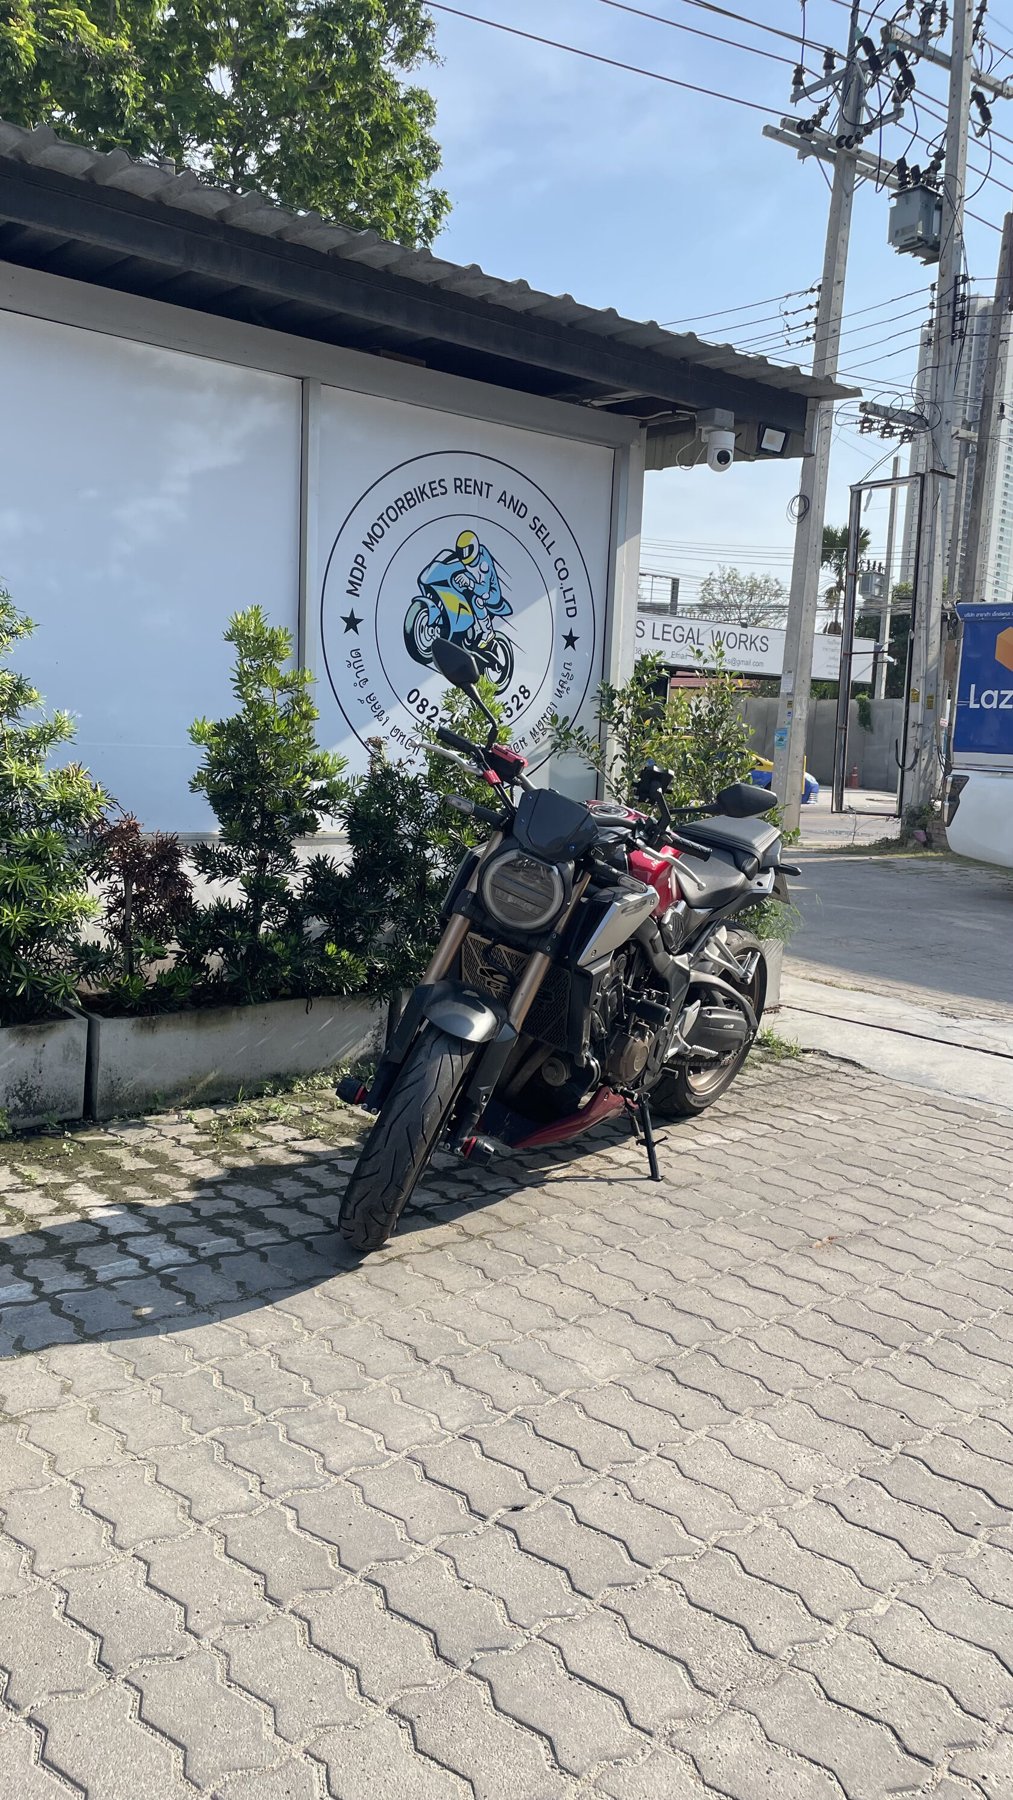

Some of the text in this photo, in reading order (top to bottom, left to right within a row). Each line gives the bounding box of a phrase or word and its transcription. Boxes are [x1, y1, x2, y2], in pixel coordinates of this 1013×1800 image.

[346, 477, 578, 619] MDP MOTORBIKES RENT AND SELL CO.,LTD
[651, 622, 705, 646] LEGAL
[711, 629, 769, 653] WORKS
[345, 648, 369, 688] จำกัด
[554, 661, 574, 699] บริษัท
[357, 692, 390, 727] เซลล์
[969, 683, 1013, 709] Laz
